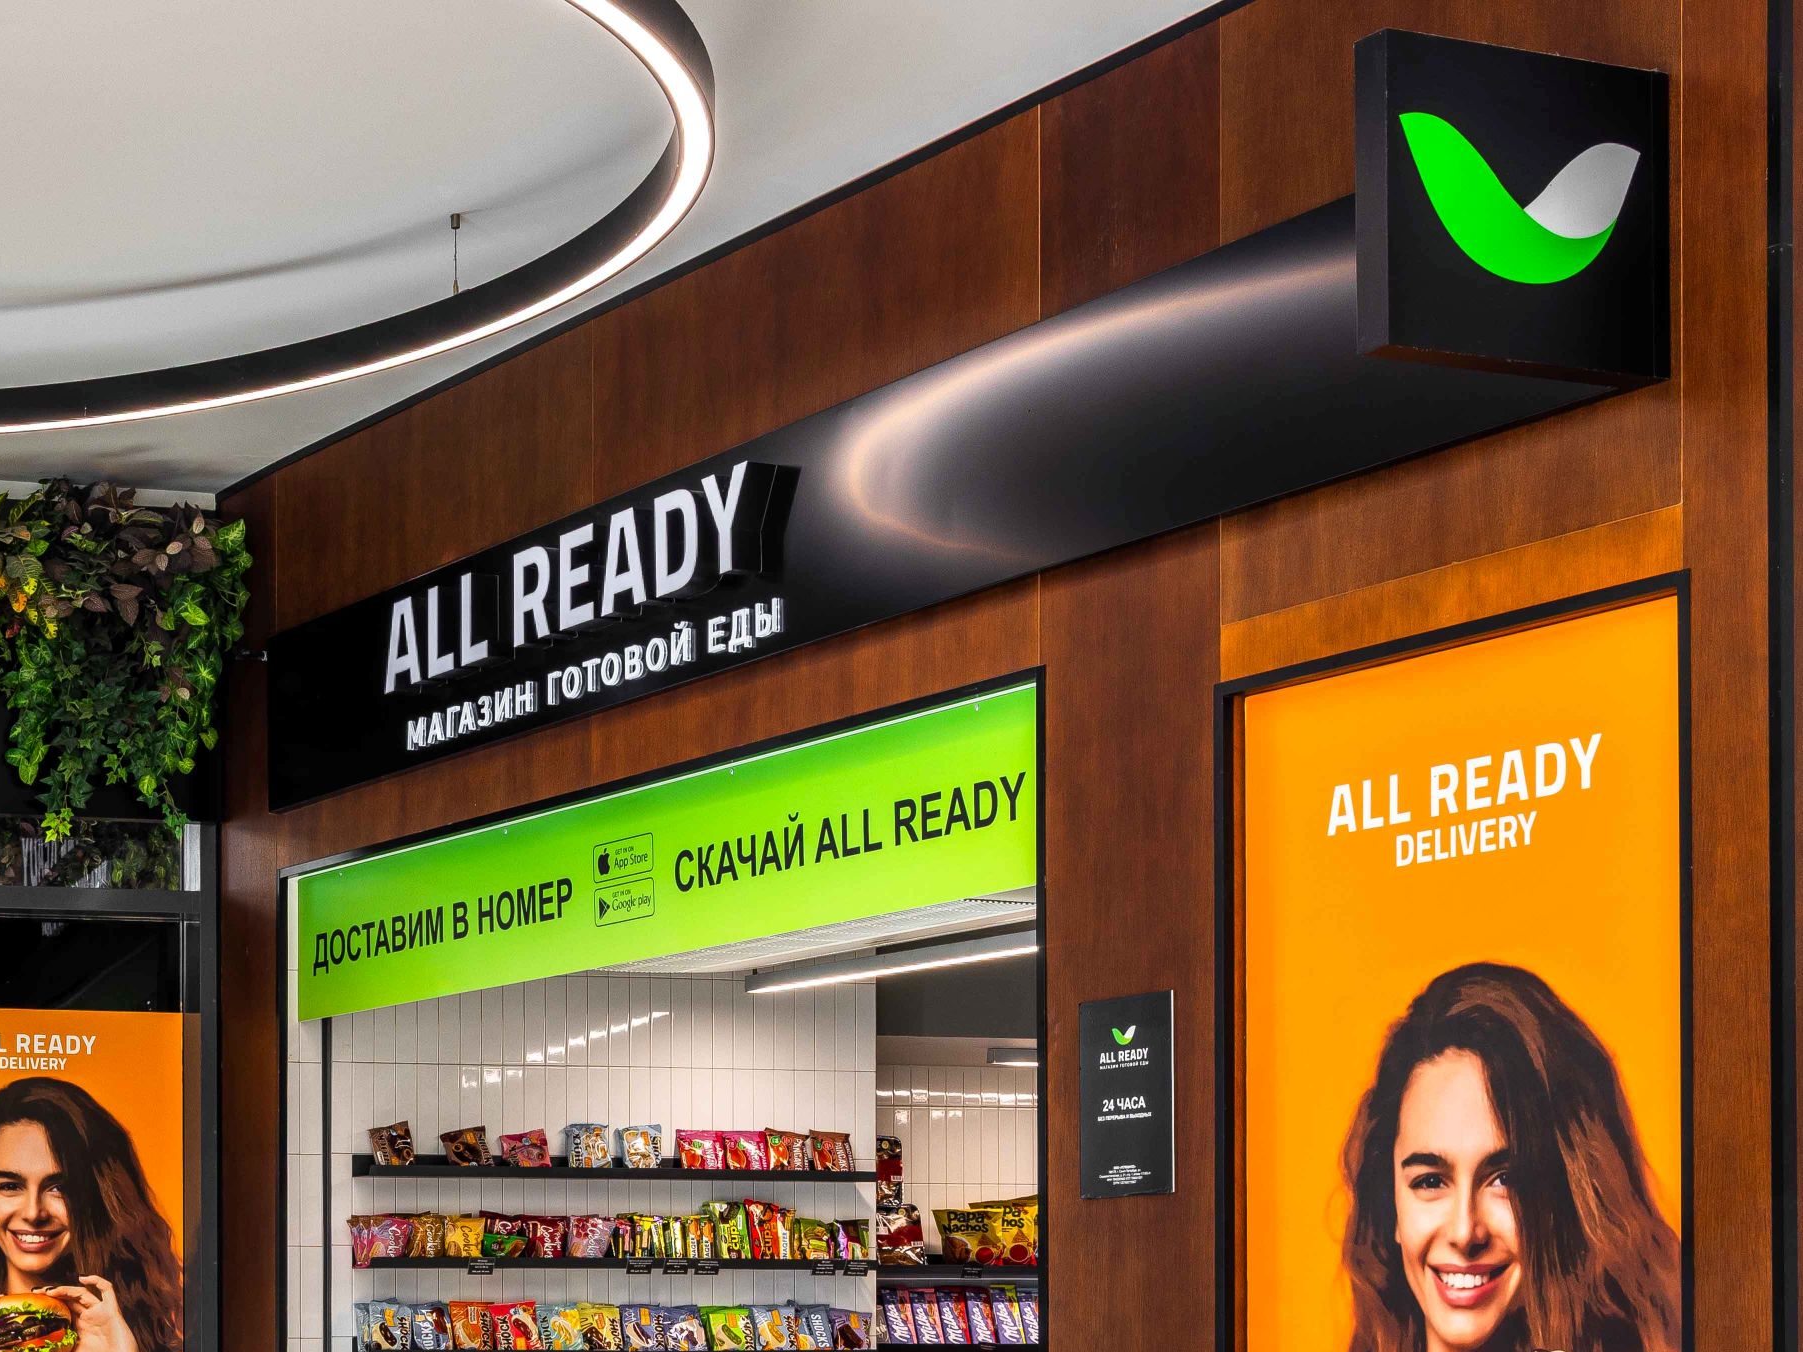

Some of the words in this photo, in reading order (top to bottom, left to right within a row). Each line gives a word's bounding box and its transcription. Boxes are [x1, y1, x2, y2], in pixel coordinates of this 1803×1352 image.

[384, 571, 489, 695] ALL
[513, 461, 749, 647] READY
[406, 681, 535, 751] МАГАЗИН
[547, 621, 697, 706] ГОТОВОЙ
[707, 598, 785, 654] ЕДЫ
[1327, 774, 1412, 836] ALL
[1430, 733, 1603, 818] READY
[1396, 811, 1538, 867] DELIVERY
[312, 914, 445, 976] ДОСТАВИМ
[452, 900, 469, 941] В
[477, 878, 573, 935] НОМЕР
[674, 812, 806, 894] СКАЧАЙ
[815, 810, 884, 868] ALL
[894, 771, 1027, 848] READY
[614, 857, 628, 870] App
[630, 853, 648, 865] Store
[612, 895, 637, 912] Google
[638, 894, 652, 908] play
[16, 1034, 97, 1055] READY
[1099, 1052, 1116, 1064] ALL
[1118, 1048, 1149, 1062] READY
[0, 1056, 68, 1070] DELIVERY
[1102, 1098, 1115, 1112] 24
[1116, 1095, 1146, 1111] ЧАСА
[811, 1313, 830, 1348] SHOCKS
